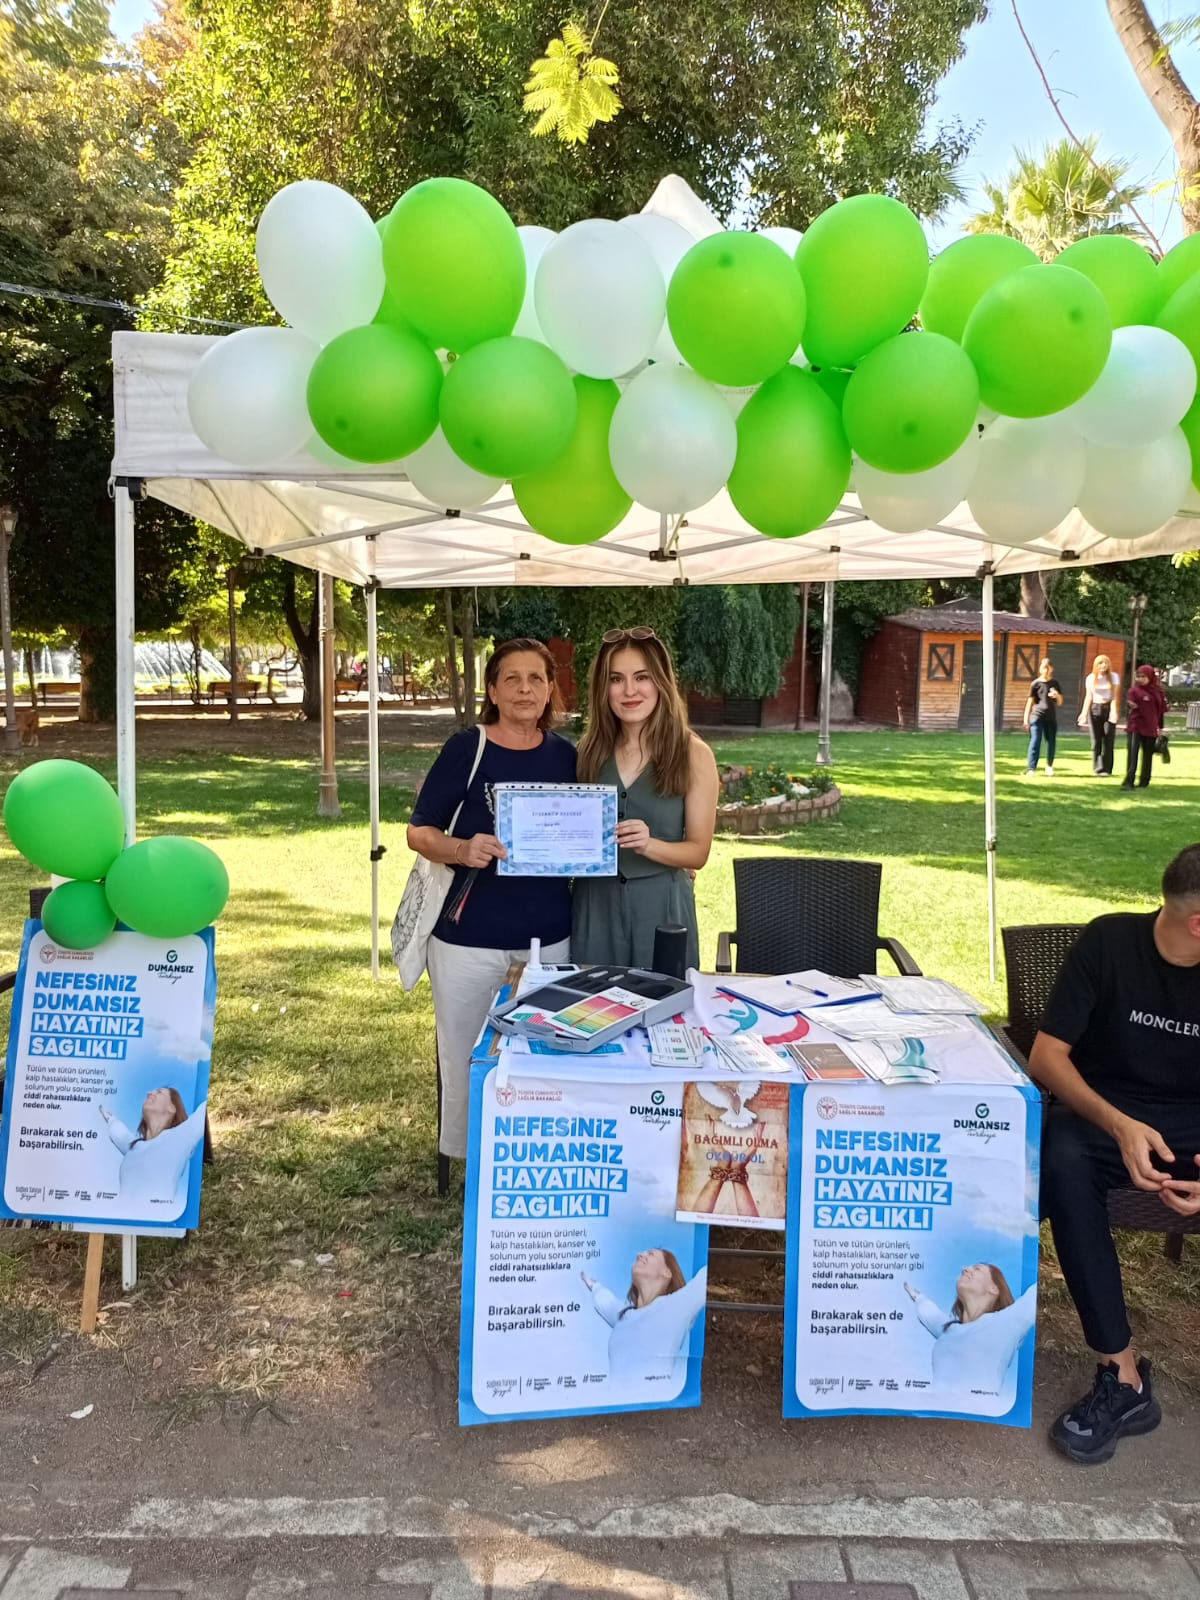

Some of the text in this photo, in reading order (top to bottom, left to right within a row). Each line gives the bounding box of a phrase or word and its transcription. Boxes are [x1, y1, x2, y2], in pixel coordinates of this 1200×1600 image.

[148, 964, 194, 973] DUMANSIZ
[33, 992, 141, 1014] DUMANSIZ
[33, 1014, 140, 1036] HAYATINIZ
[1129, 1010, 1200, 1037] MONCLER
[954, 1120, 1010, 1130] DUMANSIZ
[20, 1126, 64, 1137] Bırakarak
[86, 1130, 97, 1138] de
[19, 1138, 84, 1151] başarabilirsin.
[493, 1142, 623, 1164] DUMANSIZ
[815, 1155, 947, 1177] DUMANSIZ
[496, 1168, 623, 1190] HAYATINIZ
[818, 1178, 948, 1203] HAYATINIZ
[558, 1240, 584, 1248] kanser
[490, 1252, 526, 1260] solunum
[529, 1252, 546, 1262] yolu
[490, 1263, 510, 1271] ciddi
[851, 1261, 868, 1270] yolu
[489, 1274, 516, 1282] neden
[489, 1301, 580, 1315] Bırakarak sen de
[811, 1310, 863, 1320] Bırakarak
[890, 1310, 903, 1320] de
[488, 1317, 565, 1332] başarabilirsin.
[811, 1324, 888, 1335] başarabilirsin.
